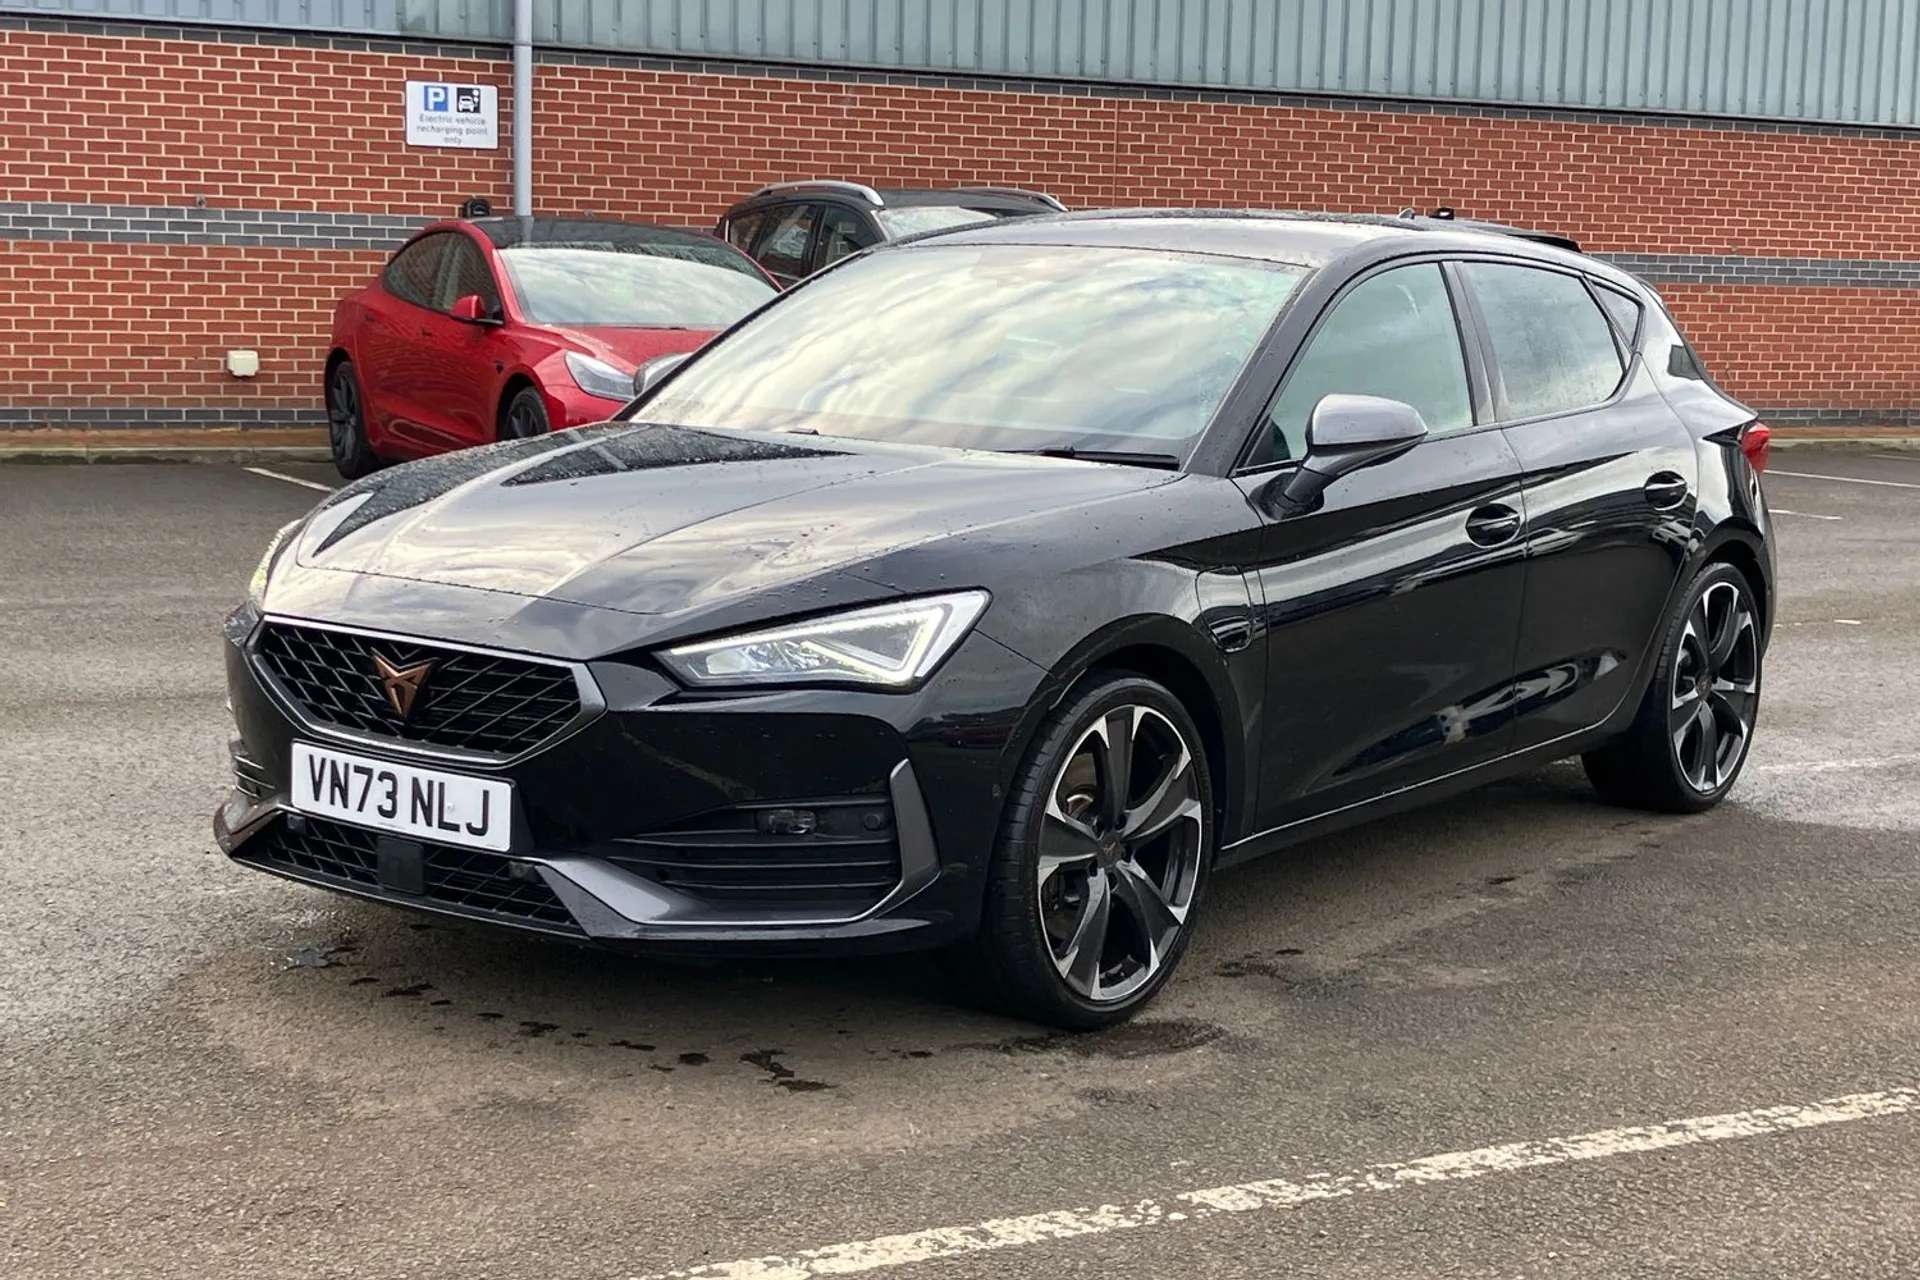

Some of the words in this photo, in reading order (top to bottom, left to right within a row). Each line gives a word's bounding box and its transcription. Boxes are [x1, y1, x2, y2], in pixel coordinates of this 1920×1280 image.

[428, 87, 446, 110] P
[419, 113, 452, 123] Electric
[455, 115, 486, 125] vehicle
[416, 124, 463, 136] recharging
[465, 126, 488, 136] point
[443, 136, 462, 145] only
[309, 754, 399, 819] VN73
[411, 776, 490, 837] NLJ
